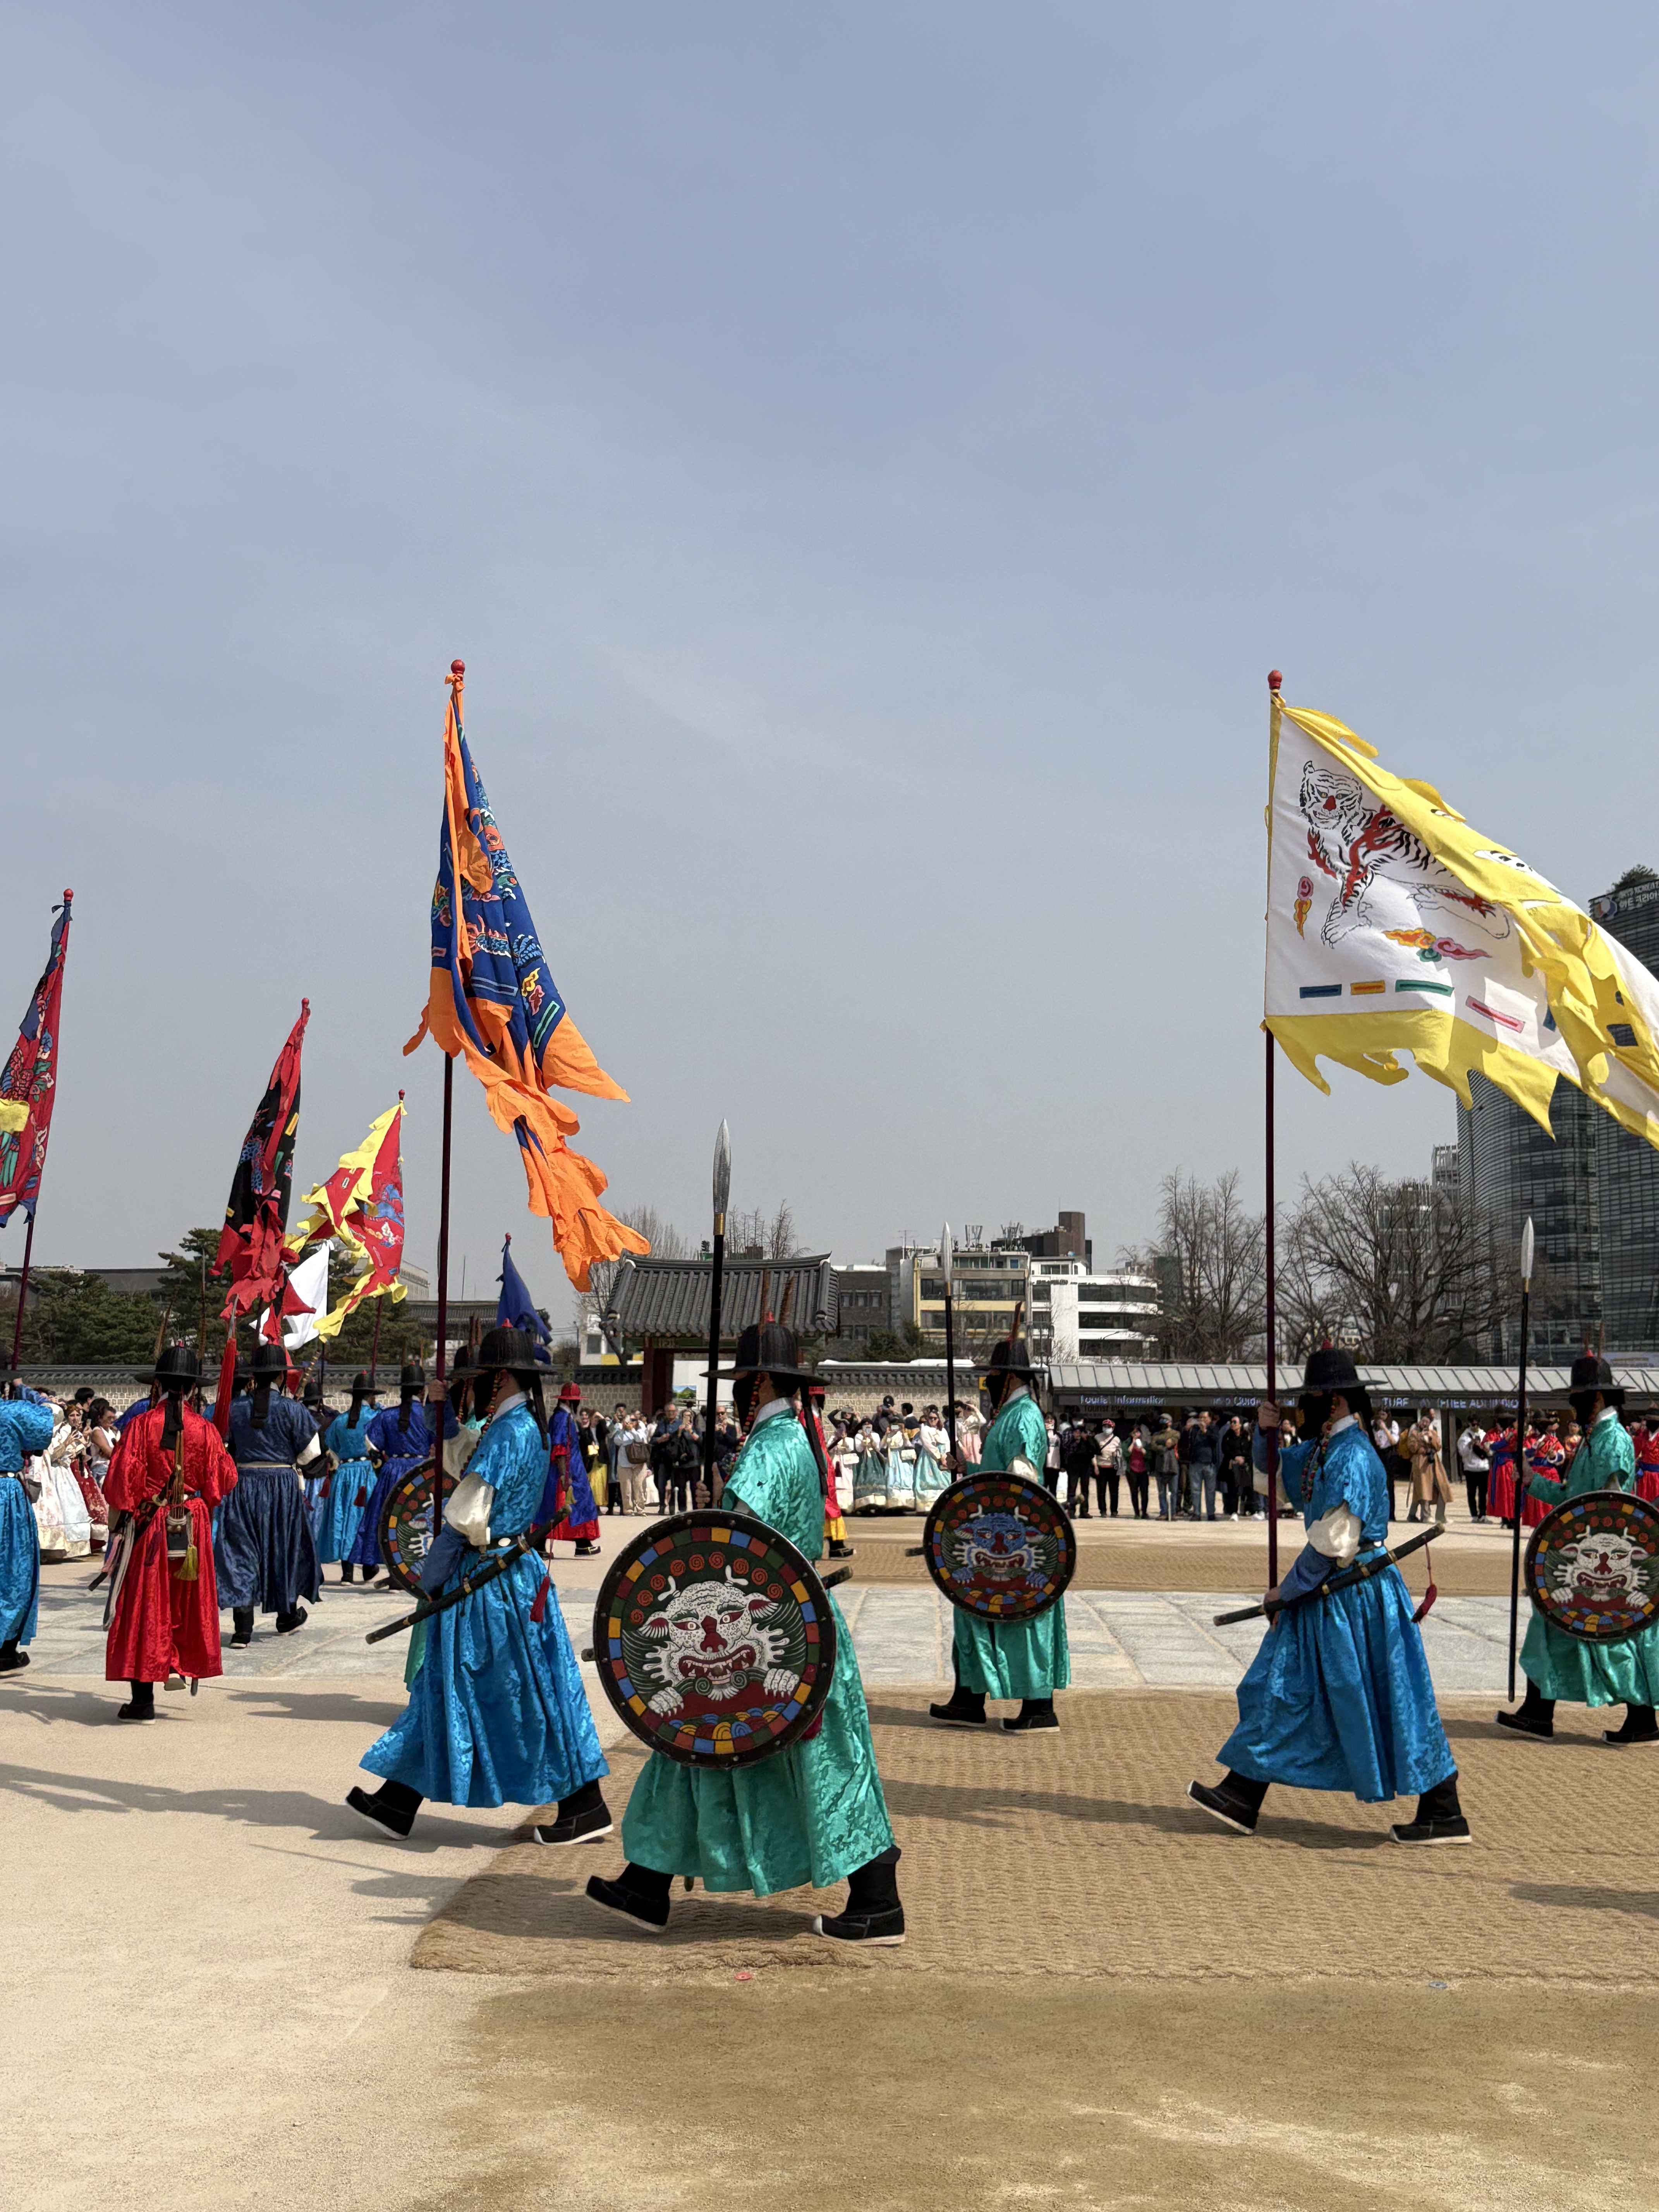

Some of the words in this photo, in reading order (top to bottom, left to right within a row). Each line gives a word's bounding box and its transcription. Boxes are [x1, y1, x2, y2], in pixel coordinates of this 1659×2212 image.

[1619, 891, 1659, 911] 아트코리아
[1079, 1395, 1111, 1405] Tourist
[1115, 1395, 1166, 1404] Information
